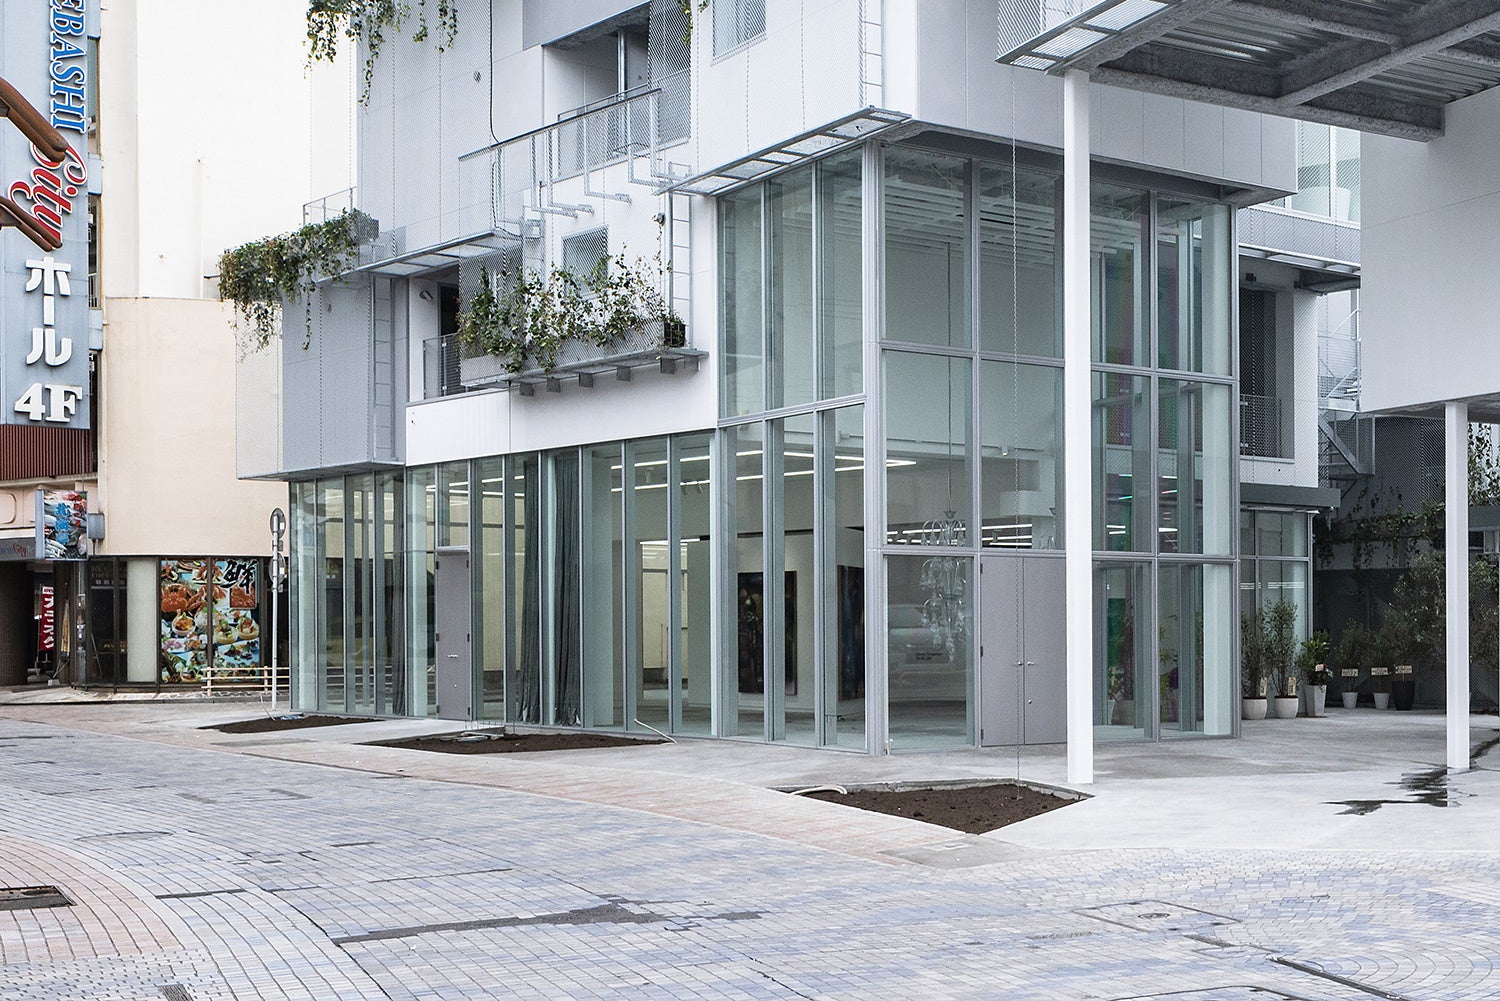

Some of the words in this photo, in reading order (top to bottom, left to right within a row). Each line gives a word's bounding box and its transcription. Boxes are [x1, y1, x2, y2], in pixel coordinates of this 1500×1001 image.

[25, 256, 72, 366] ホール
[14, 382, 83, 423] 4F
